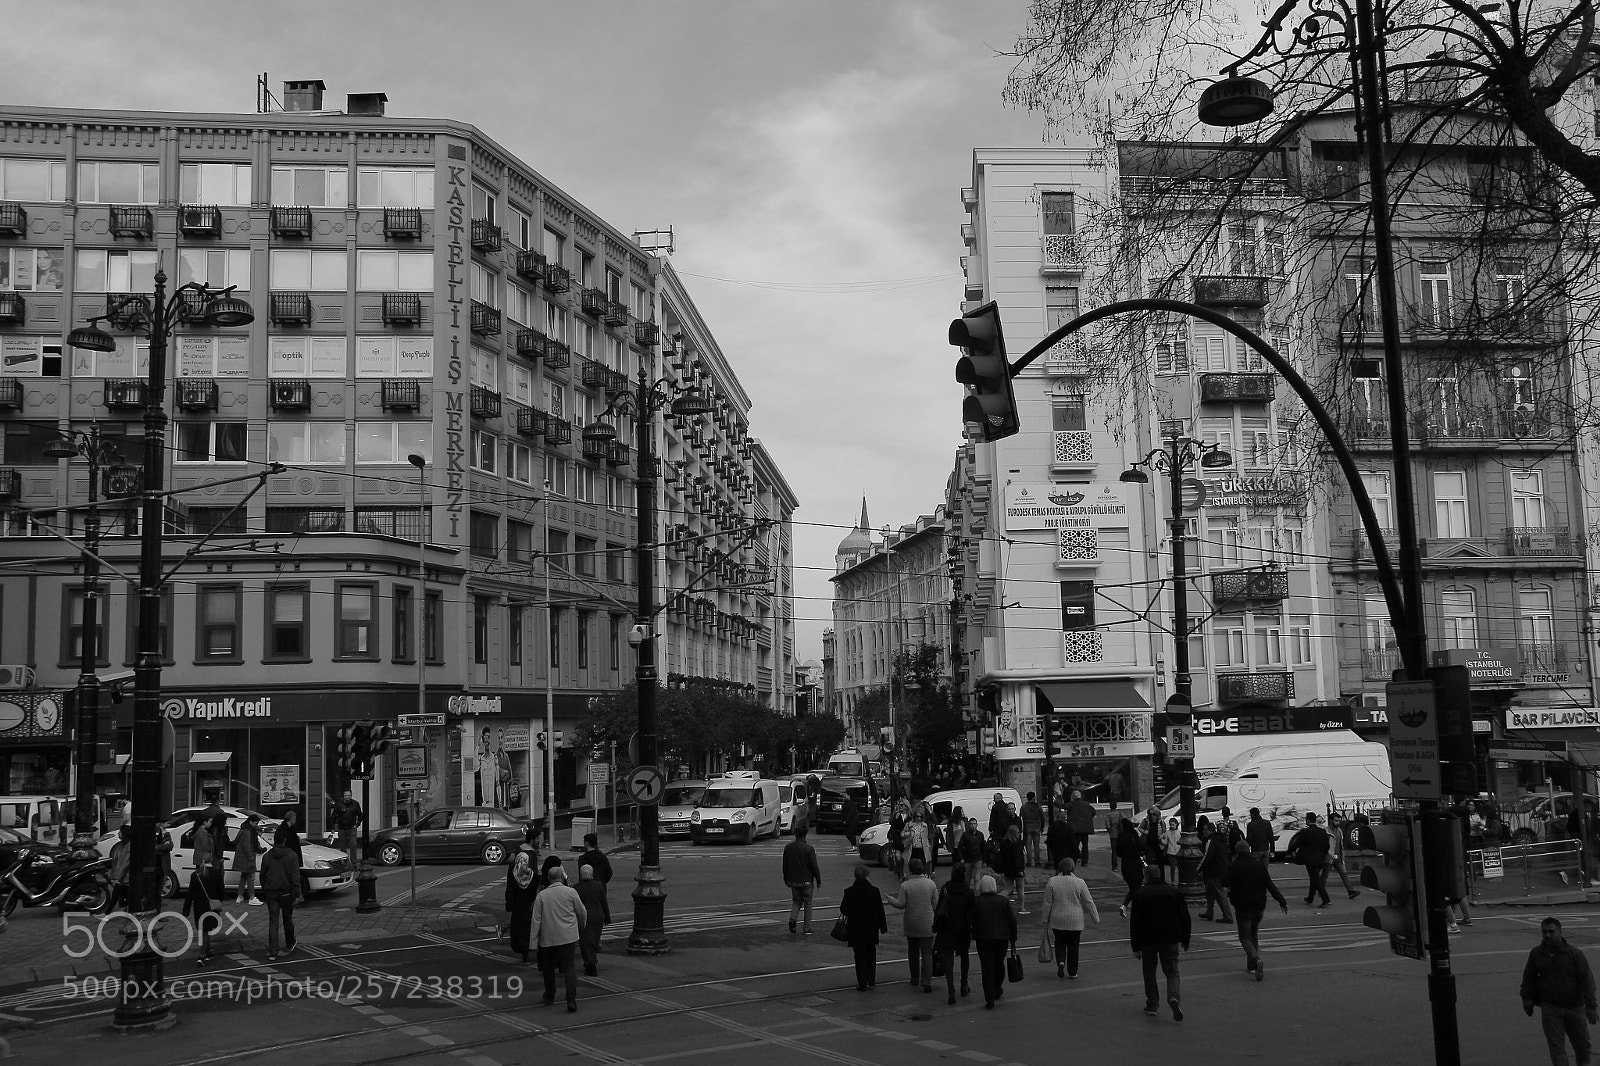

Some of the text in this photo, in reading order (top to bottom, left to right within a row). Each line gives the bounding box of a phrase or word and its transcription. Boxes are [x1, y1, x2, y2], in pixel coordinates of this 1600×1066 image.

[445, 391, 466, 538] MERKEZİ
[1476, 651, 1491, 659] T.C.
[1465, 659, 1504, 669] İSTANBUL
[1471, 667, 1513, 678] NOTERLİĞİ
[186, 697, 272, 721] YapıKredi
[1070, 743, 1105, 757] Safa
[1171, 744, 1189, 752] EDS
